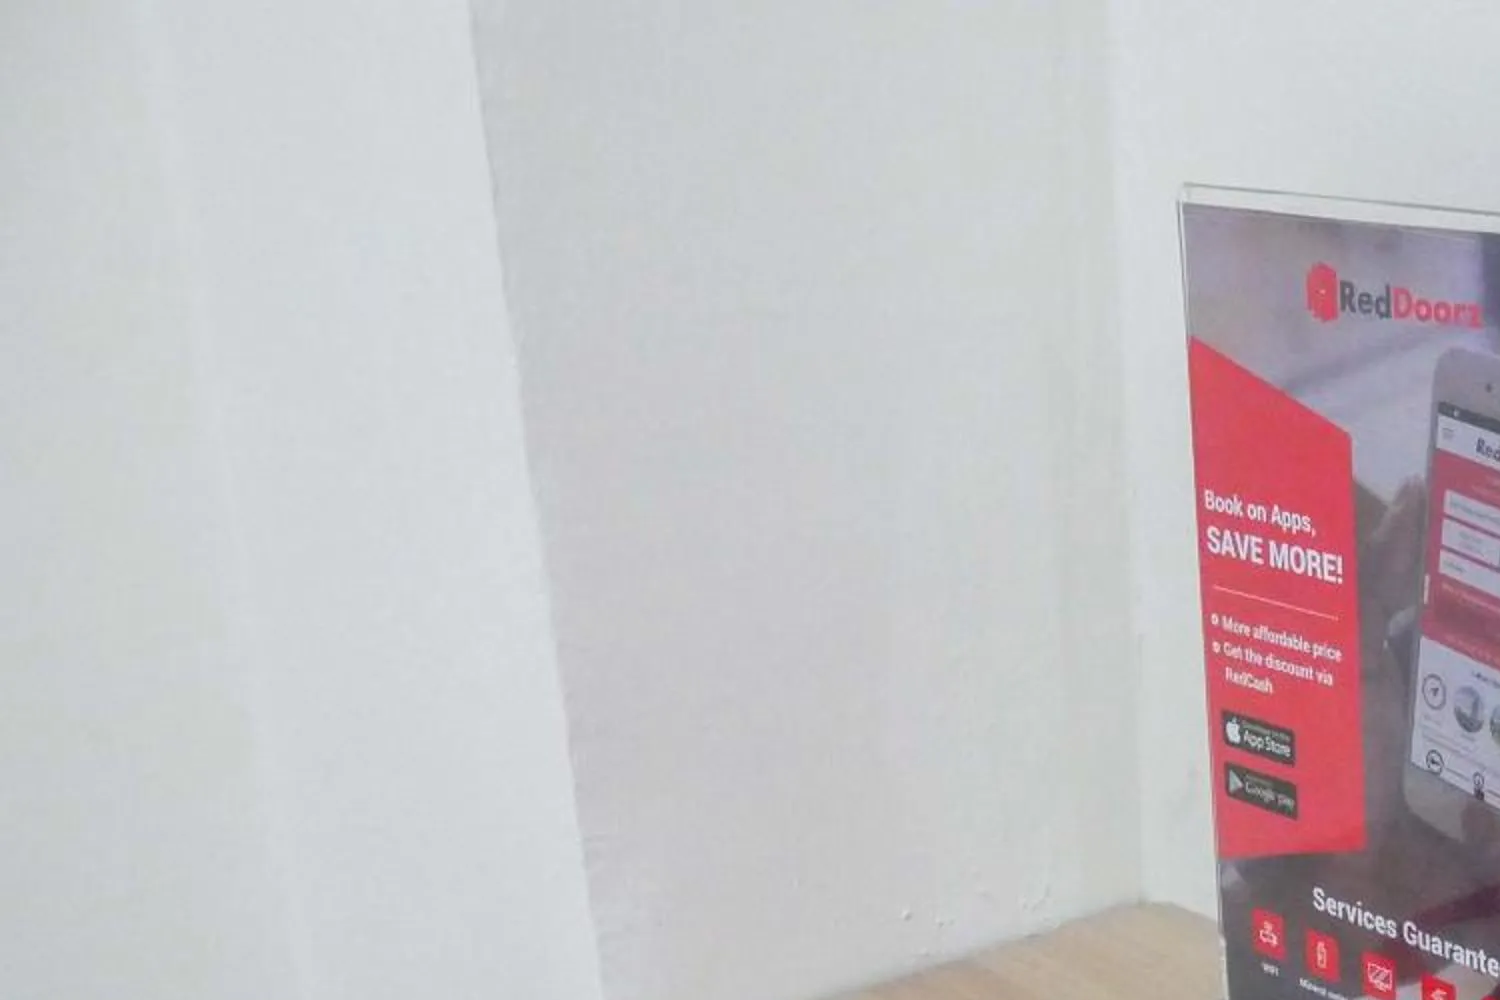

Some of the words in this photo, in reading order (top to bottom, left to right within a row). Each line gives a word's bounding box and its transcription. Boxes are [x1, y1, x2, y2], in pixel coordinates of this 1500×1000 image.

[1340, 280, 1483, 329] RedDoorz
[1203, 487, 1243, 517] Book
[1247, 501, 1266, 522] on
[1271, 504, 1316, 538] Apps,
[1206, 525, 1264, 565] SAVE
[1268, 539, 1342, 584] MORE!
[1221, 615, 1249, 636] More
[1252, 623, 1310, 653] affordable
[1311, 639, 1341, 665] price
[1223, 641, 1242, 659] Get
[1245, 647, 1262, 665] the
[1265, 652, 1312, 681] discount
[1316, 668, 1333, 687] via
[1312, 885, 1396, 939] Services
